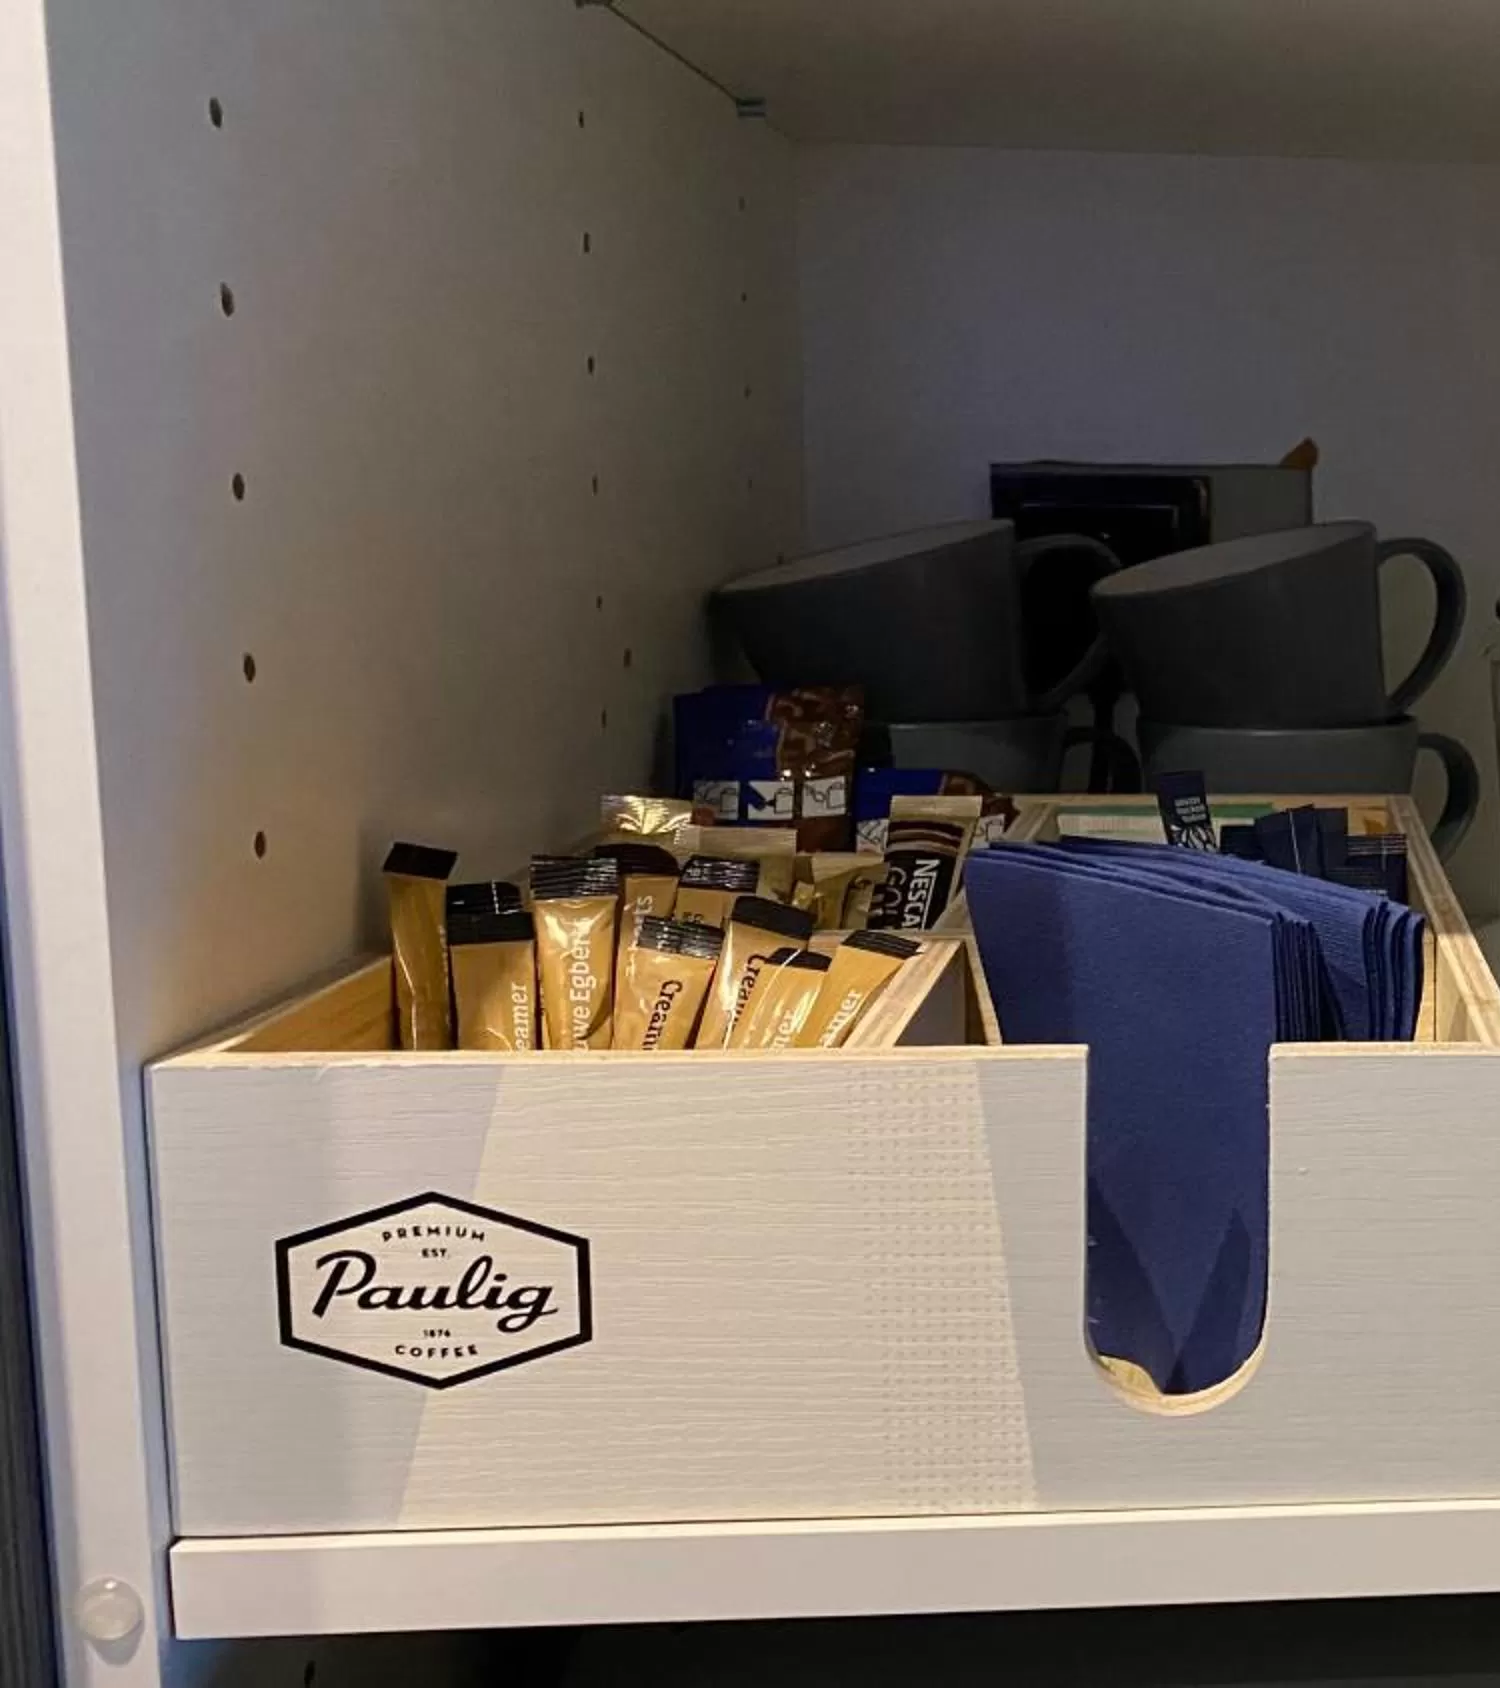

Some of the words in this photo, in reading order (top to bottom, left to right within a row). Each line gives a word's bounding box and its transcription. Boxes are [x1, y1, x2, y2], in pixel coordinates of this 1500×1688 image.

[902, 858, 941, 930] NESCA
[510, 981, 530, 1051] eamer
[641, 979, 683, 1051] Cream
[382, 1225, 486, 1242] PREMIUM
[311, 1249, 559, 1333] Paulig
[394, 1343, 479, 1359] COFFEE
